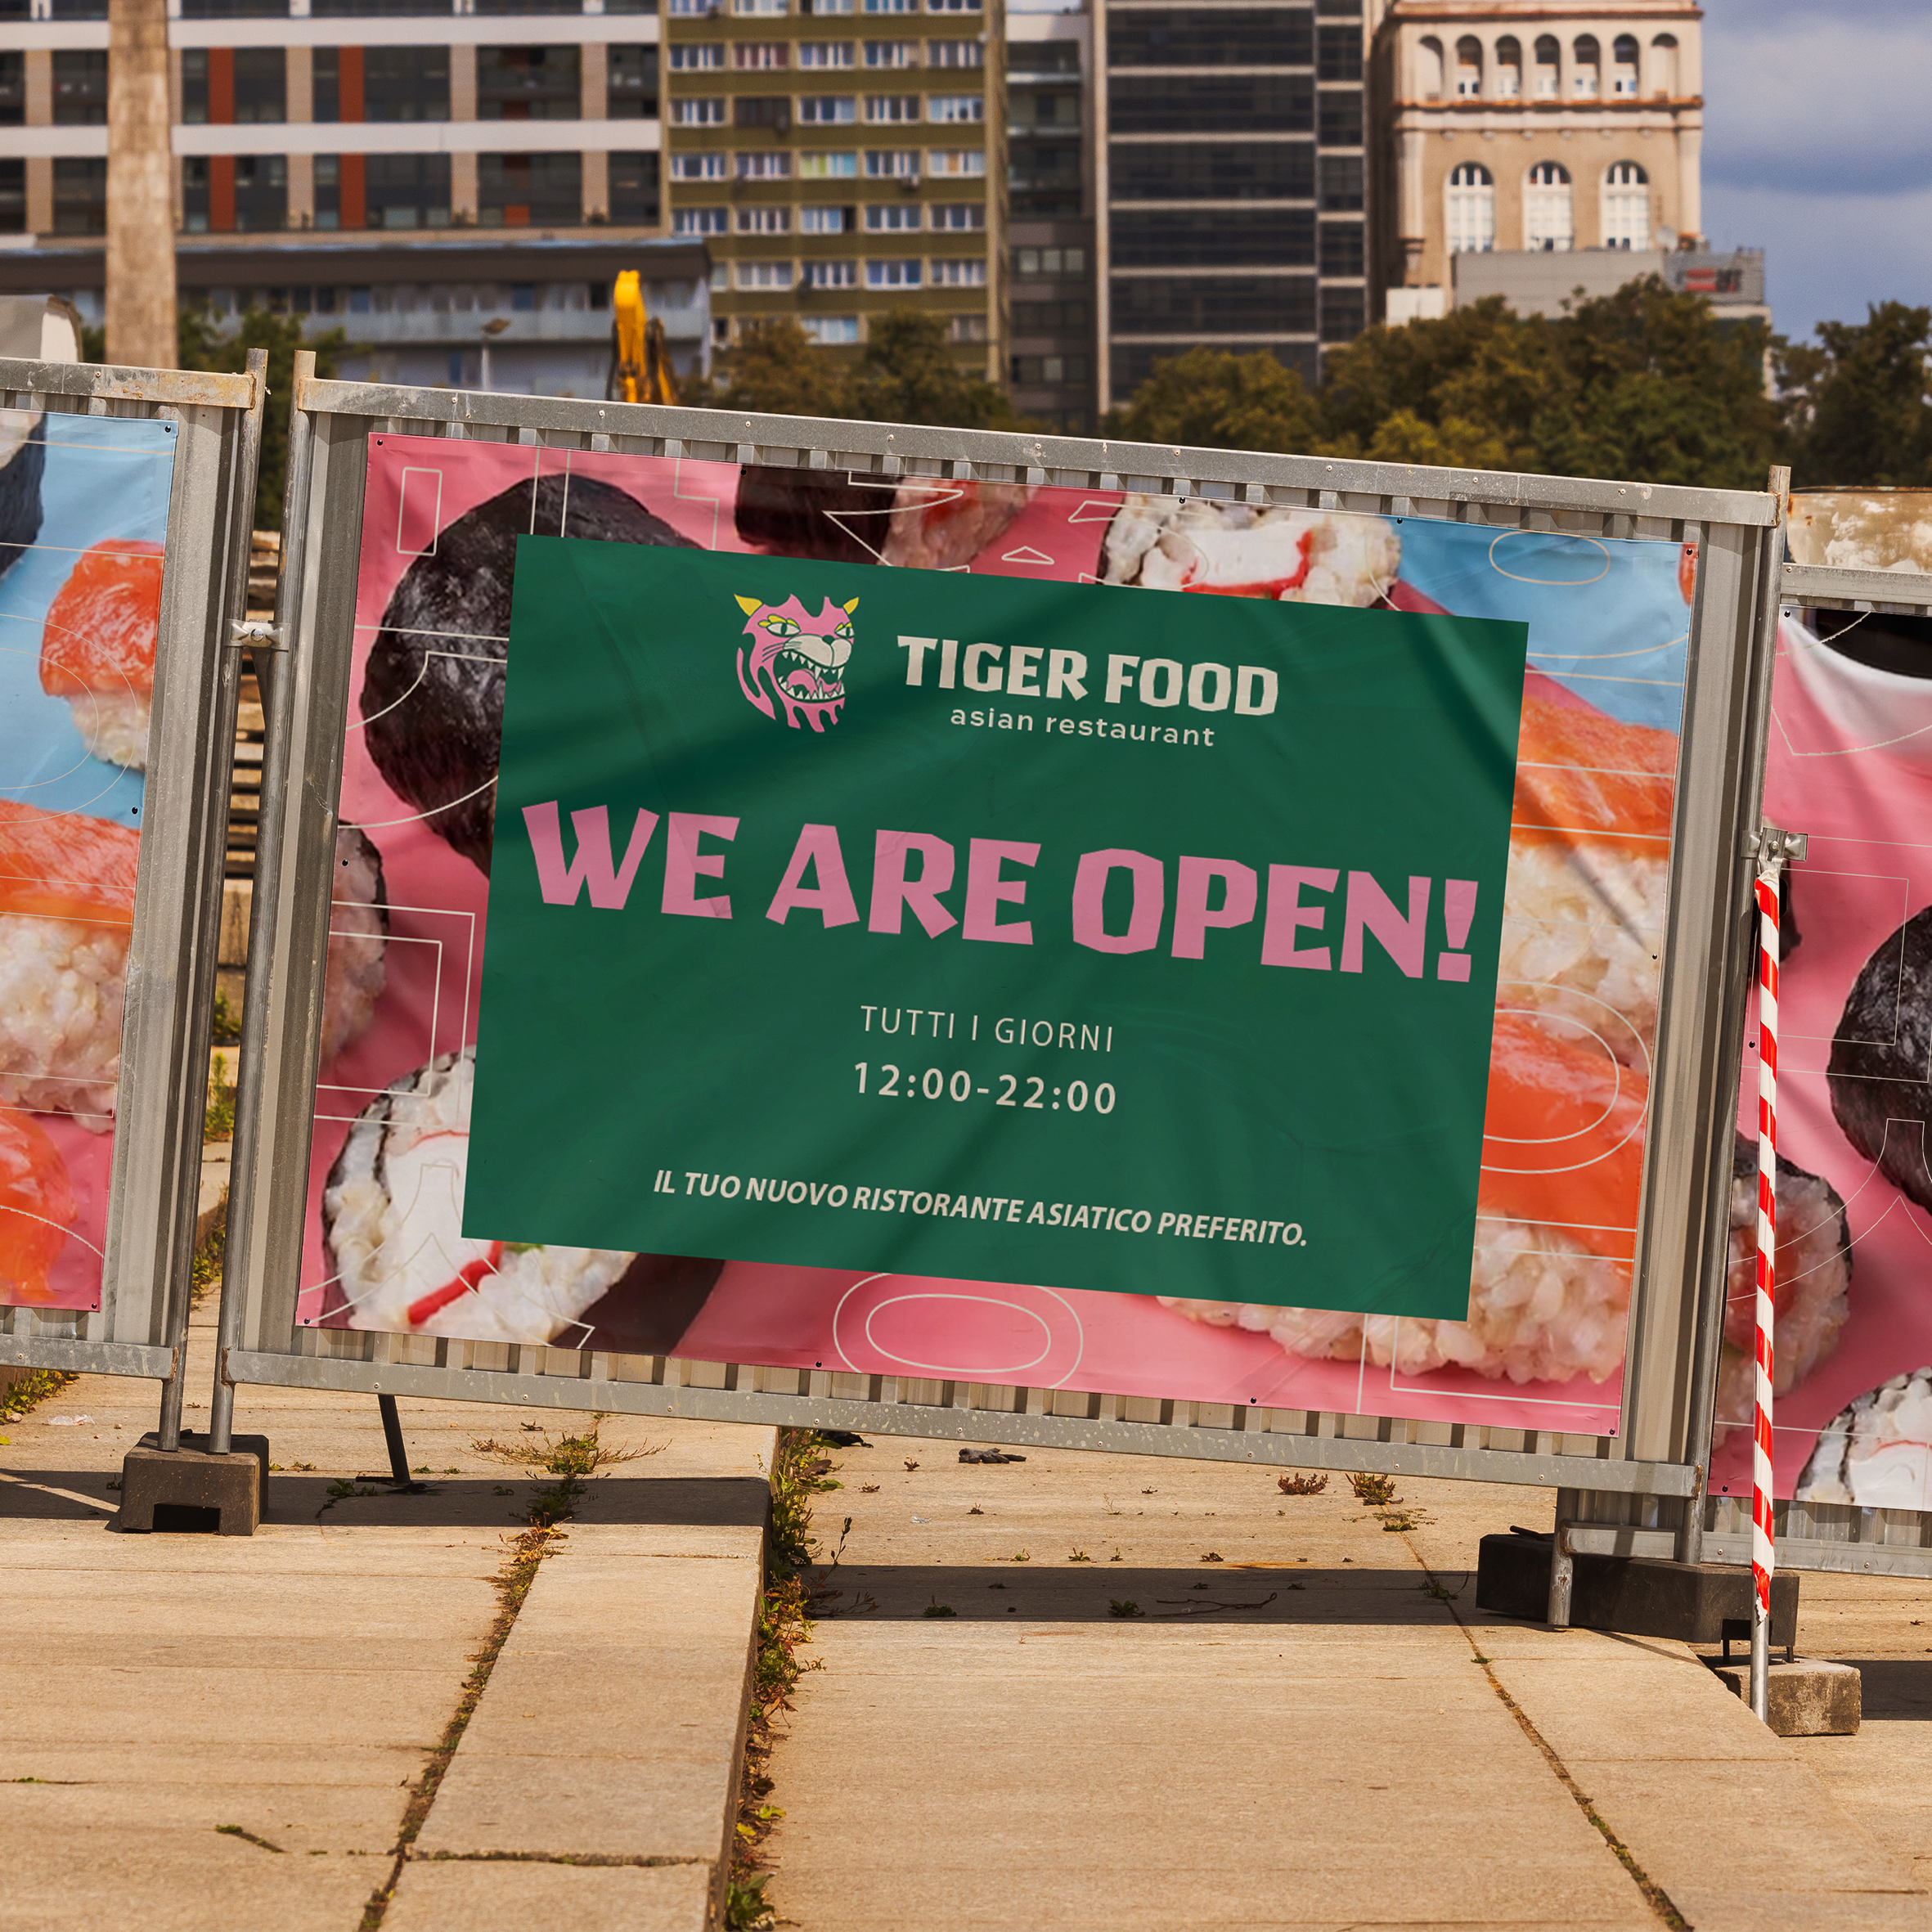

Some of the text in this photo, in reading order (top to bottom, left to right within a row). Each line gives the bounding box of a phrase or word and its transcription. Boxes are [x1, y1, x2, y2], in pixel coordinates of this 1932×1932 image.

[897, 636, 1278, 716] TIGER FOOD
[950, 708, 1215, 747] asian restaurant
[521, 800, 1479, 983] WE ARE OPEN!
[860, 1005, 1113, 1052] TUTTI I GIORNI
[855, 1062, 1116, 1114] 12:00-22:00
[654, 1170, 1307, 1247] IL TUO NUOVO RISTORANTE ASIATICO PREFERITO.
